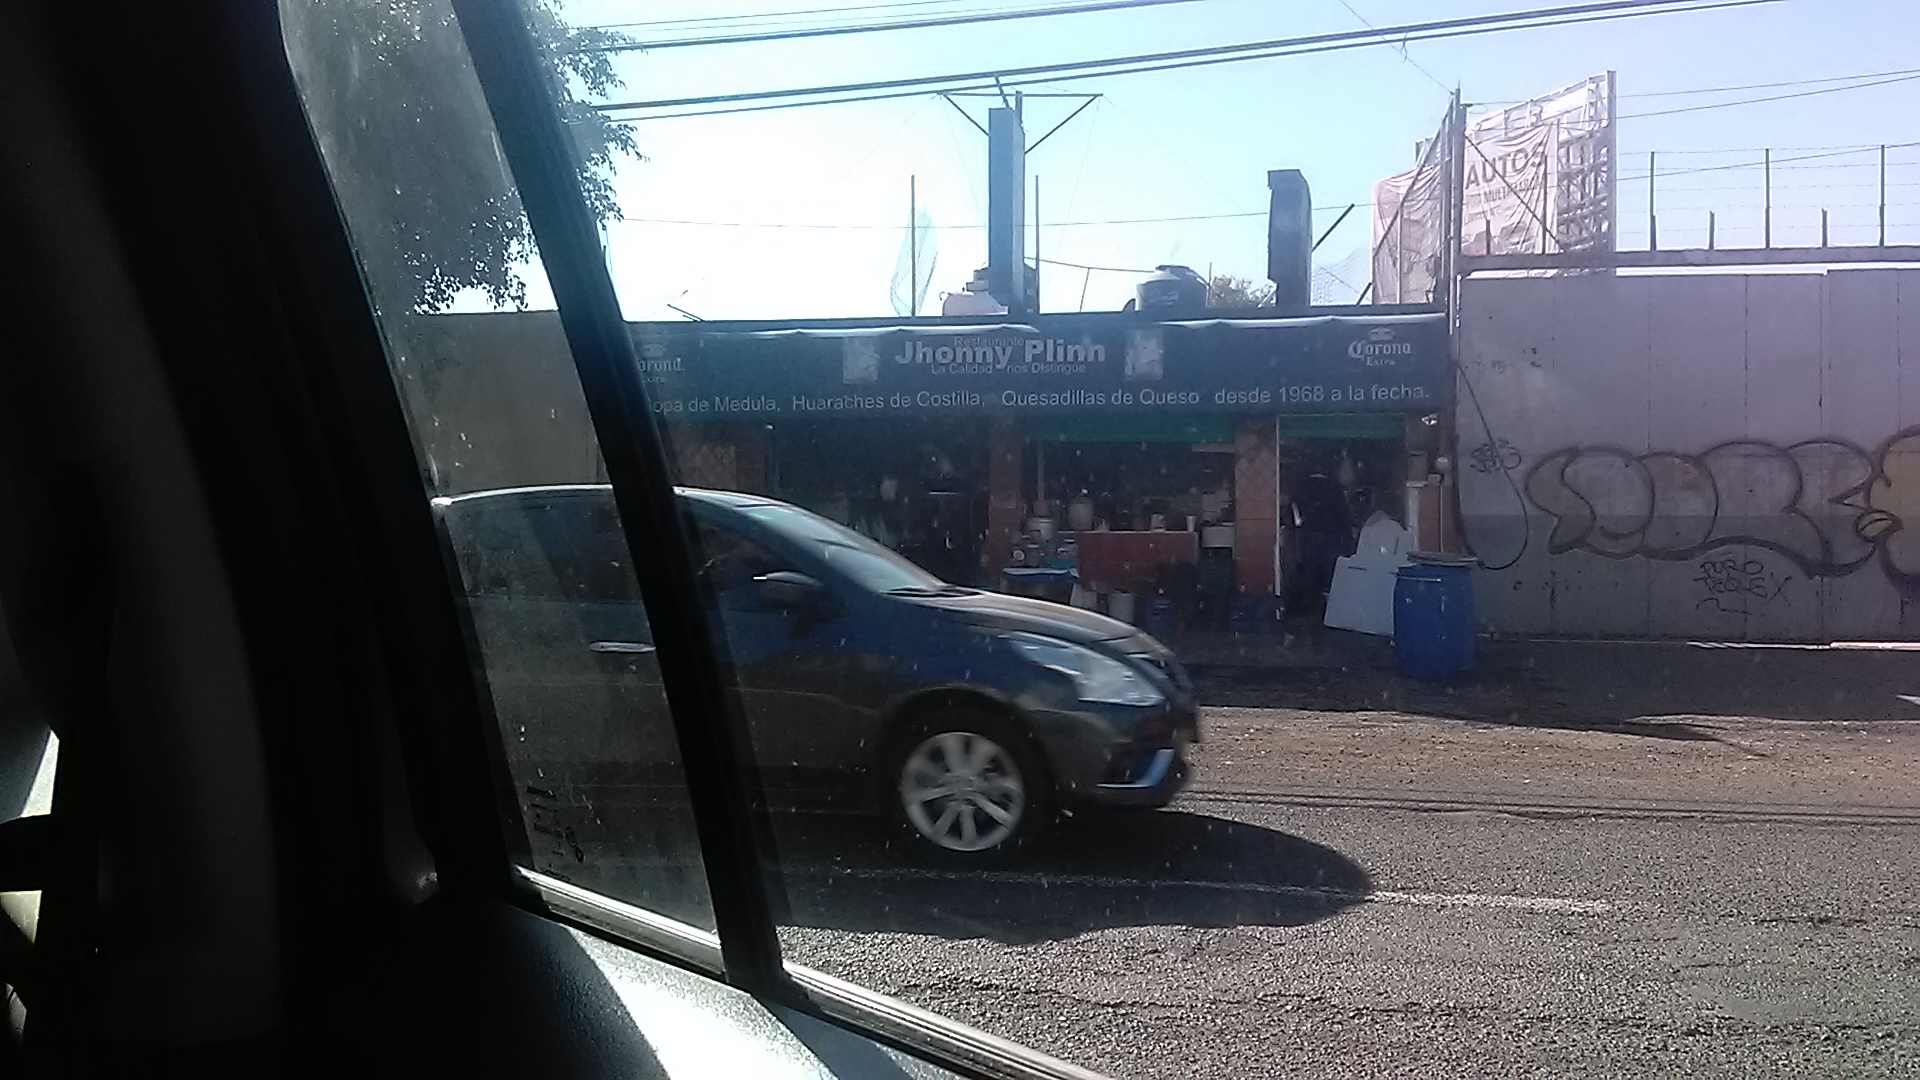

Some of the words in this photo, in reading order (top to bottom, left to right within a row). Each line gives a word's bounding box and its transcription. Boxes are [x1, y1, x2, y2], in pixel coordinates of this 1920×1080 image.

[954, 336, 1024, 347] Restaurante
[895, 340, 1013, 369] Jhonny
[1025, 339, 1106, 363] Plinn
[1347, 340, 1412, 360] Corona
[931, 363, 946, 374] La
[950, 363, 993, 374] Calidad
[1007, 364, 1027, 374] nos
[1031, 362, 1086, 375] Distingue
[1366, 356, 1395, 366] Extra
[650, 400, 683, 416] opa
[689, 397, 709, 412] de
[714, 395, 780, 412] Medula,
[793, 394, 885, 411] Huaraches
[890, 393, 911, 408] de
[917, 391, 985, 408] Costilla,
[1002, 389, 1106, 406] Quesadillas
[1111, 389, 1133, 404] de
[1140, 388, 1199, 405] Queso
[1214, 388, 1271, 404] desde
[1278, 386, 1324, 402] 1968
[1331, 389, 1342, 401] a
[1349, 385, 1364, 401] la
[1371, 384, 1430, 400] fecha.
